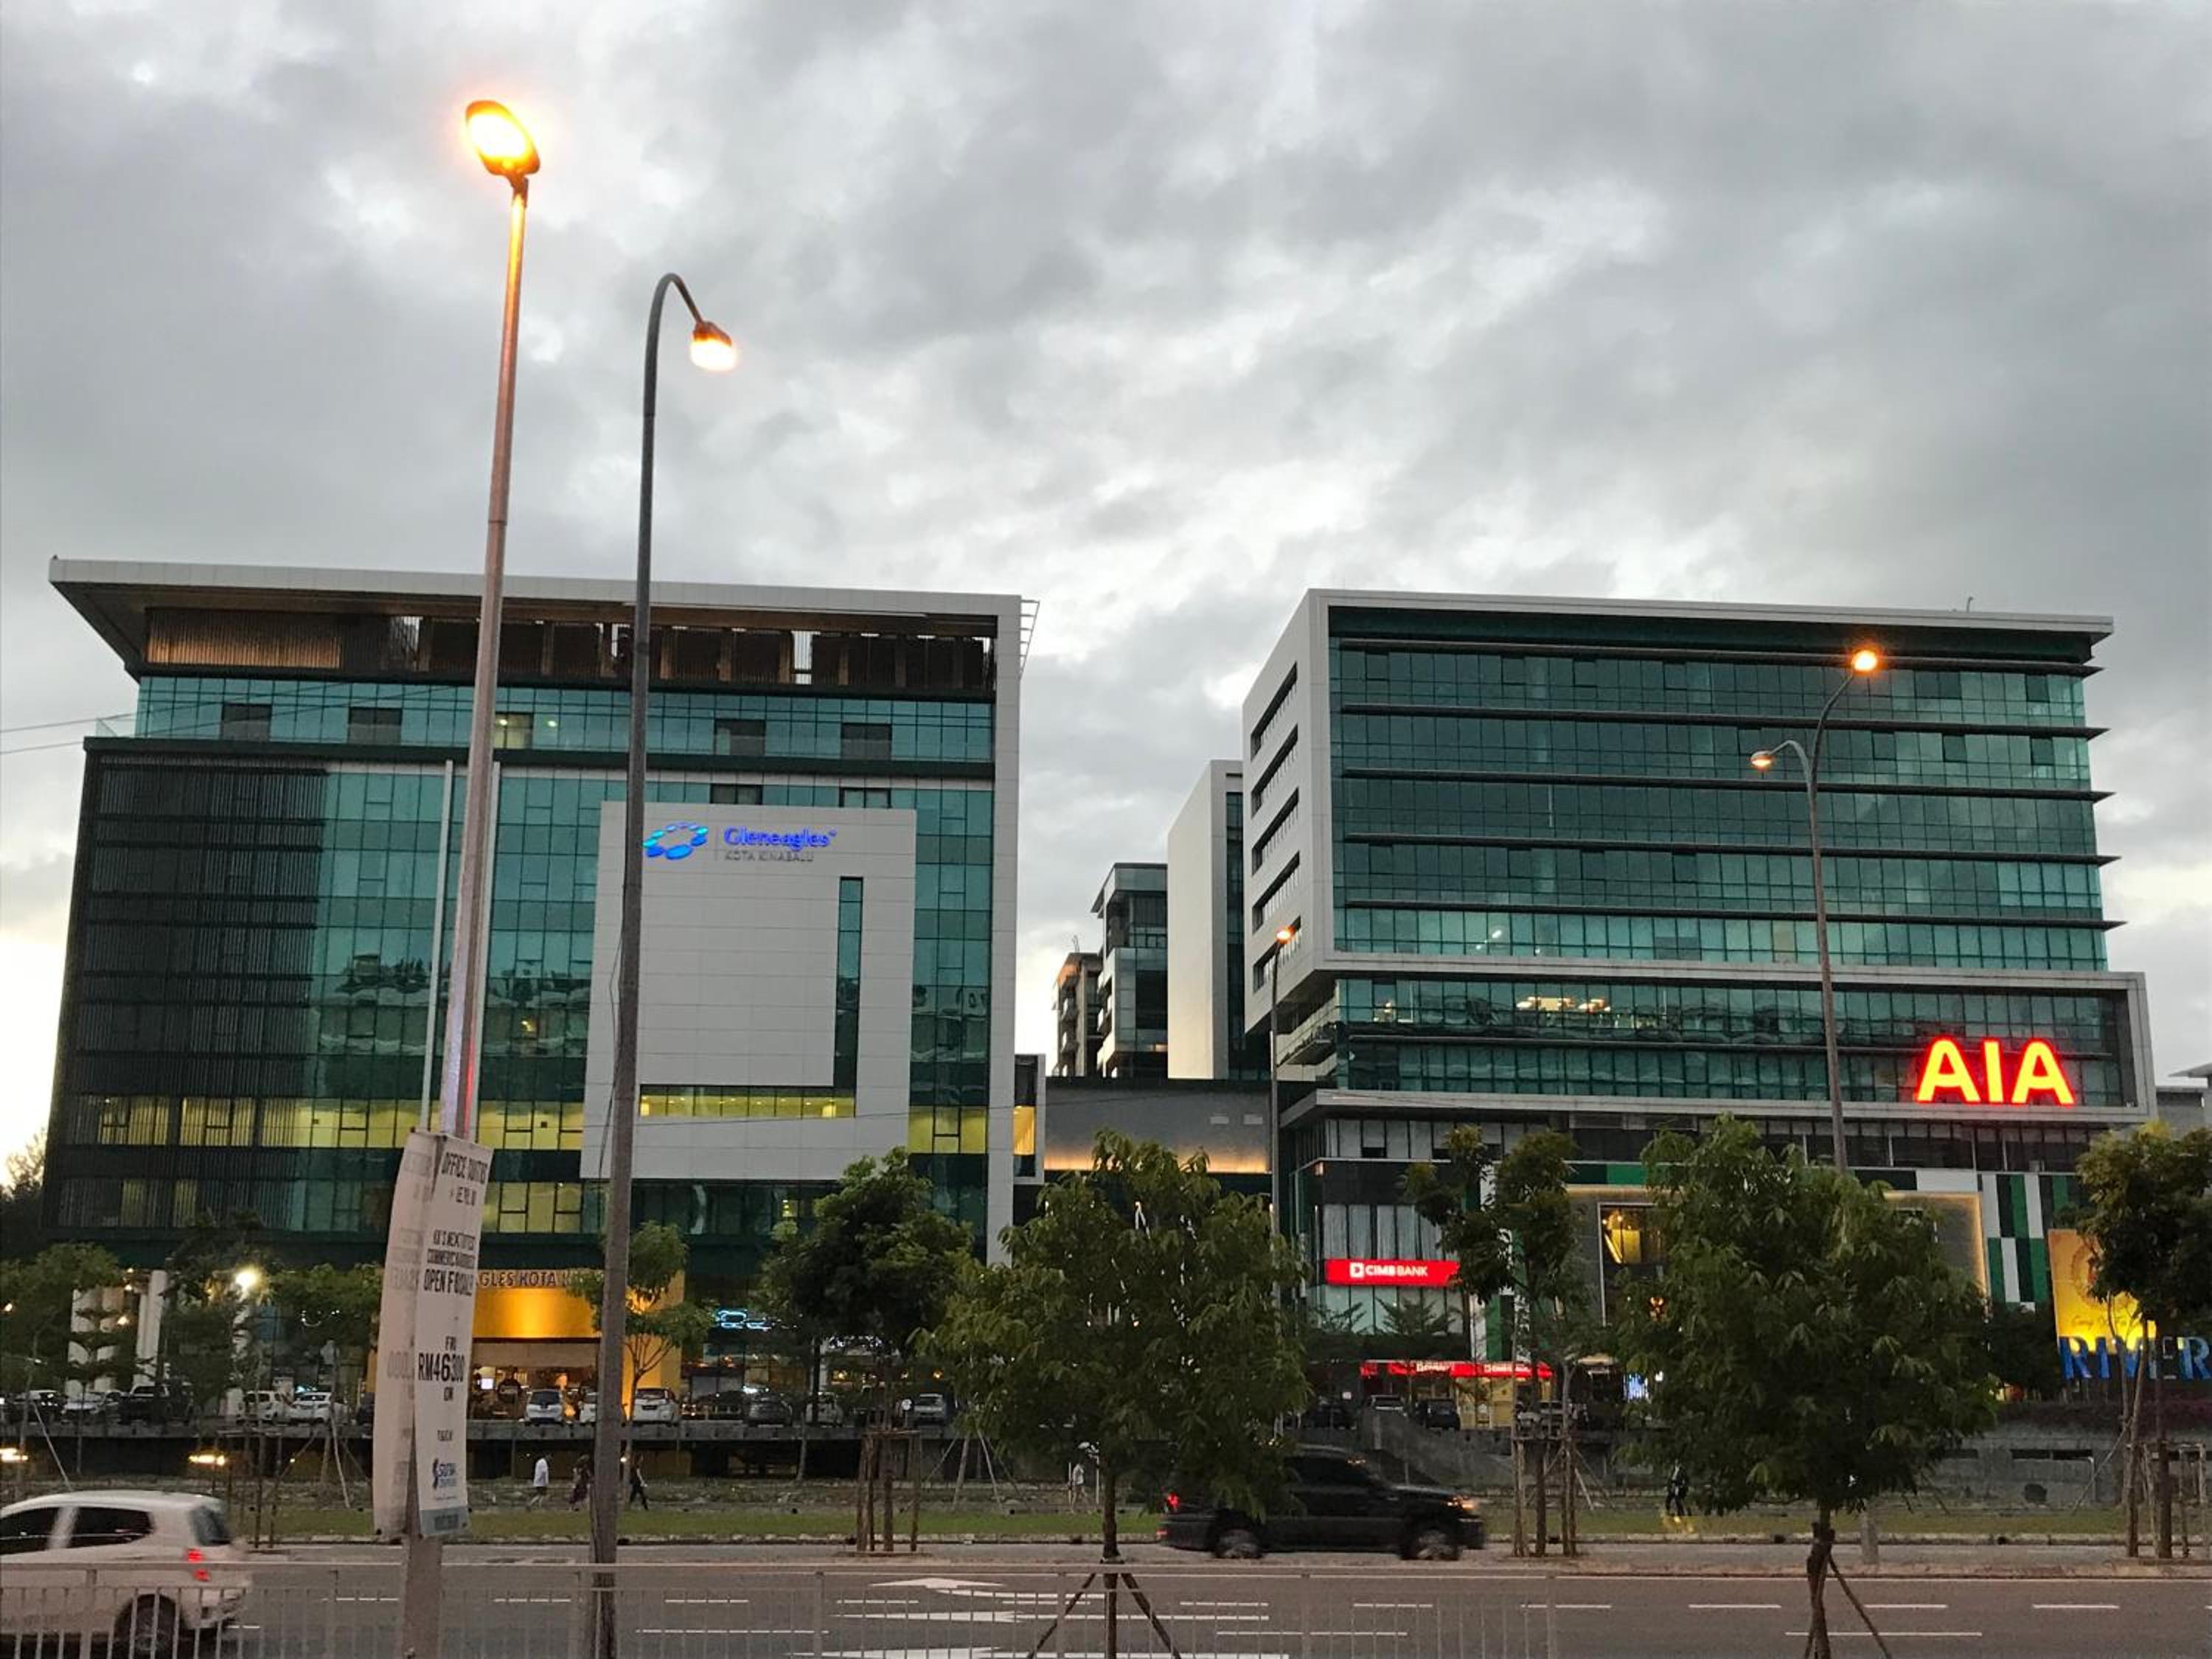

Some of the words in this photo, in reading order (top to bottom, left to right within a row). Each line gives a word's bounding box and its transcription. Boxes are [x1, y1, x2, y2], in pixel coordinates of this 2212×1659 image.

[724, 826, 830, 851] Gleneagles
[1916, 1039, 2074, 1105] AIA
[519, 1271, 557, 1287] KOTA
[1366, 1264, 1396, 1277] CIMB
[1397, 1265, 1428, 1277] BANK
